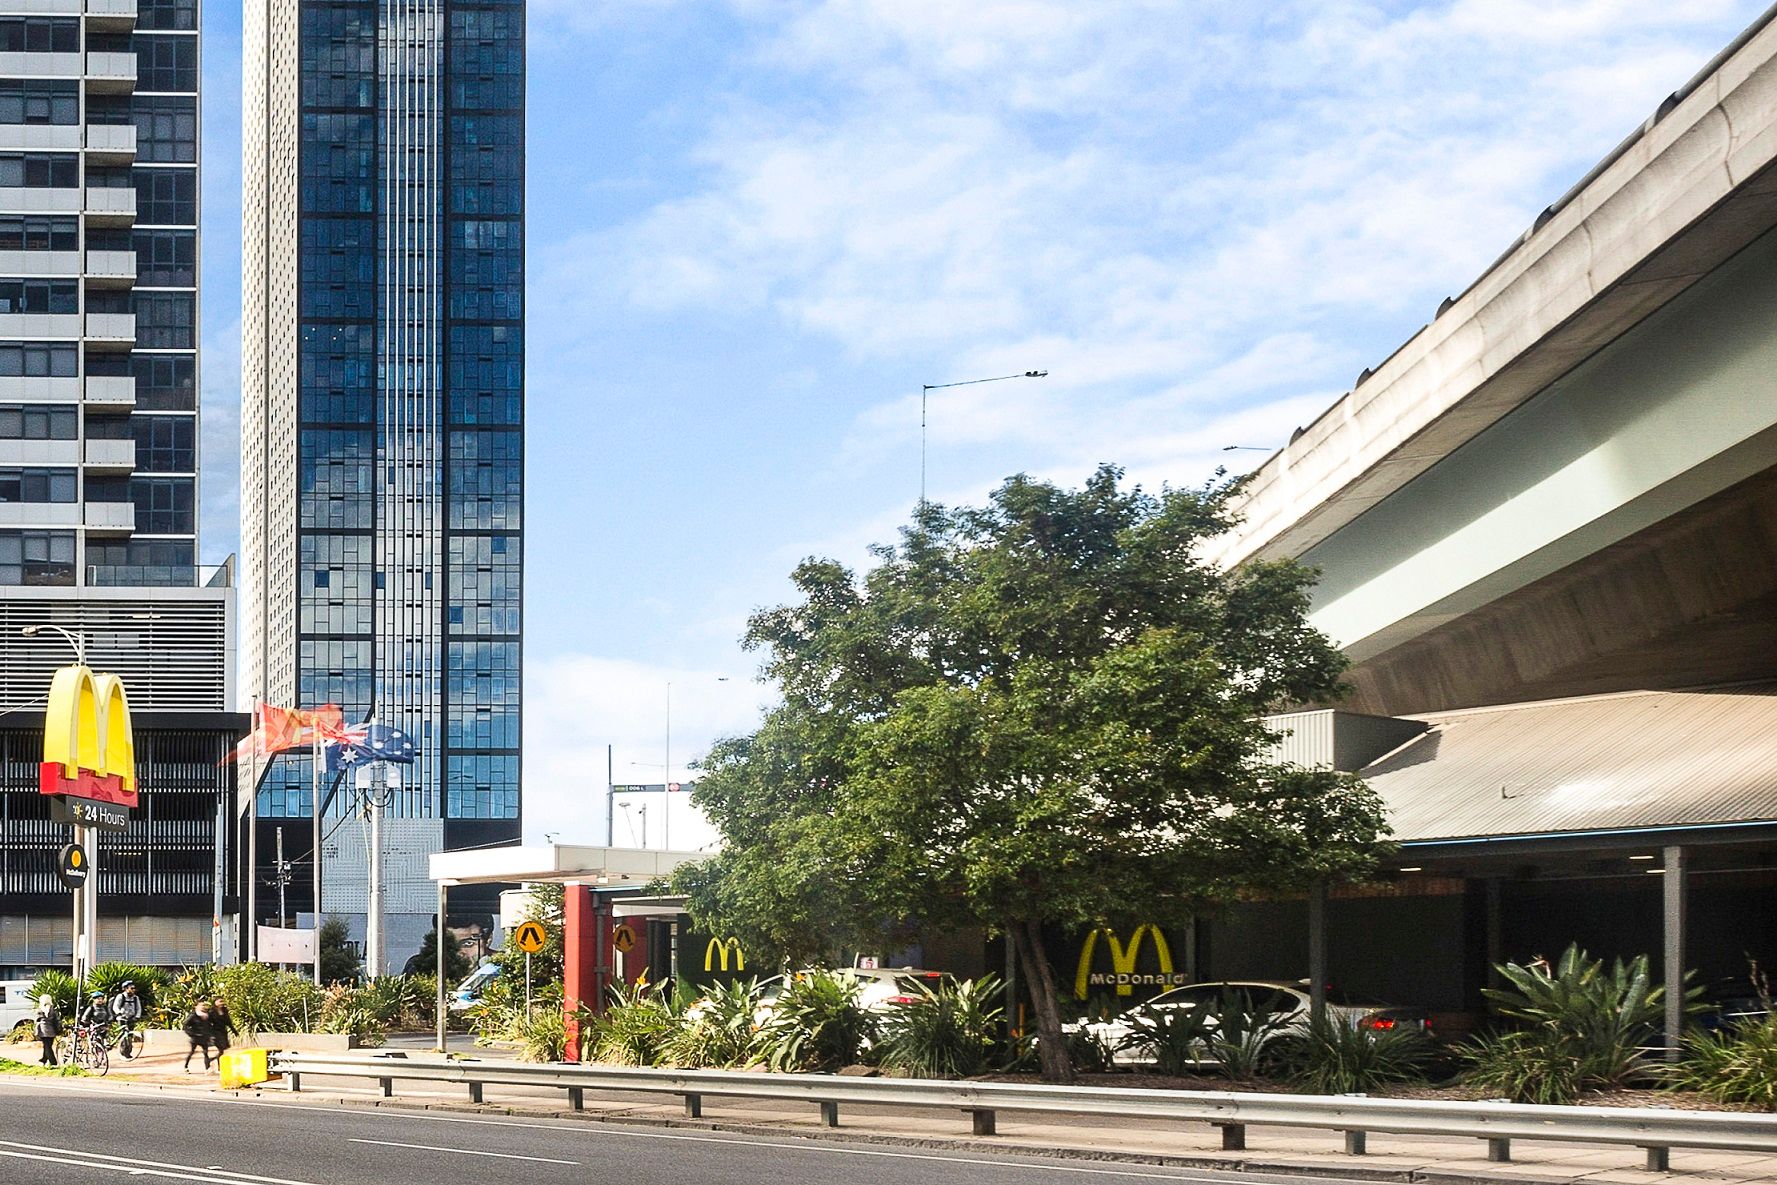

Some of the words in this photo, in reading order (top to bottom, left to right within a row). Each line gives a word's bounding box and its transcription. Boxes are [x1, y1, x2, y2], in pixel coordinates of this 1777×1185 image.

[84, 804, 98, 822] 24
[99, 806, 125, 827] Hours
[1089, 973, 1188, 985] McDonald'
